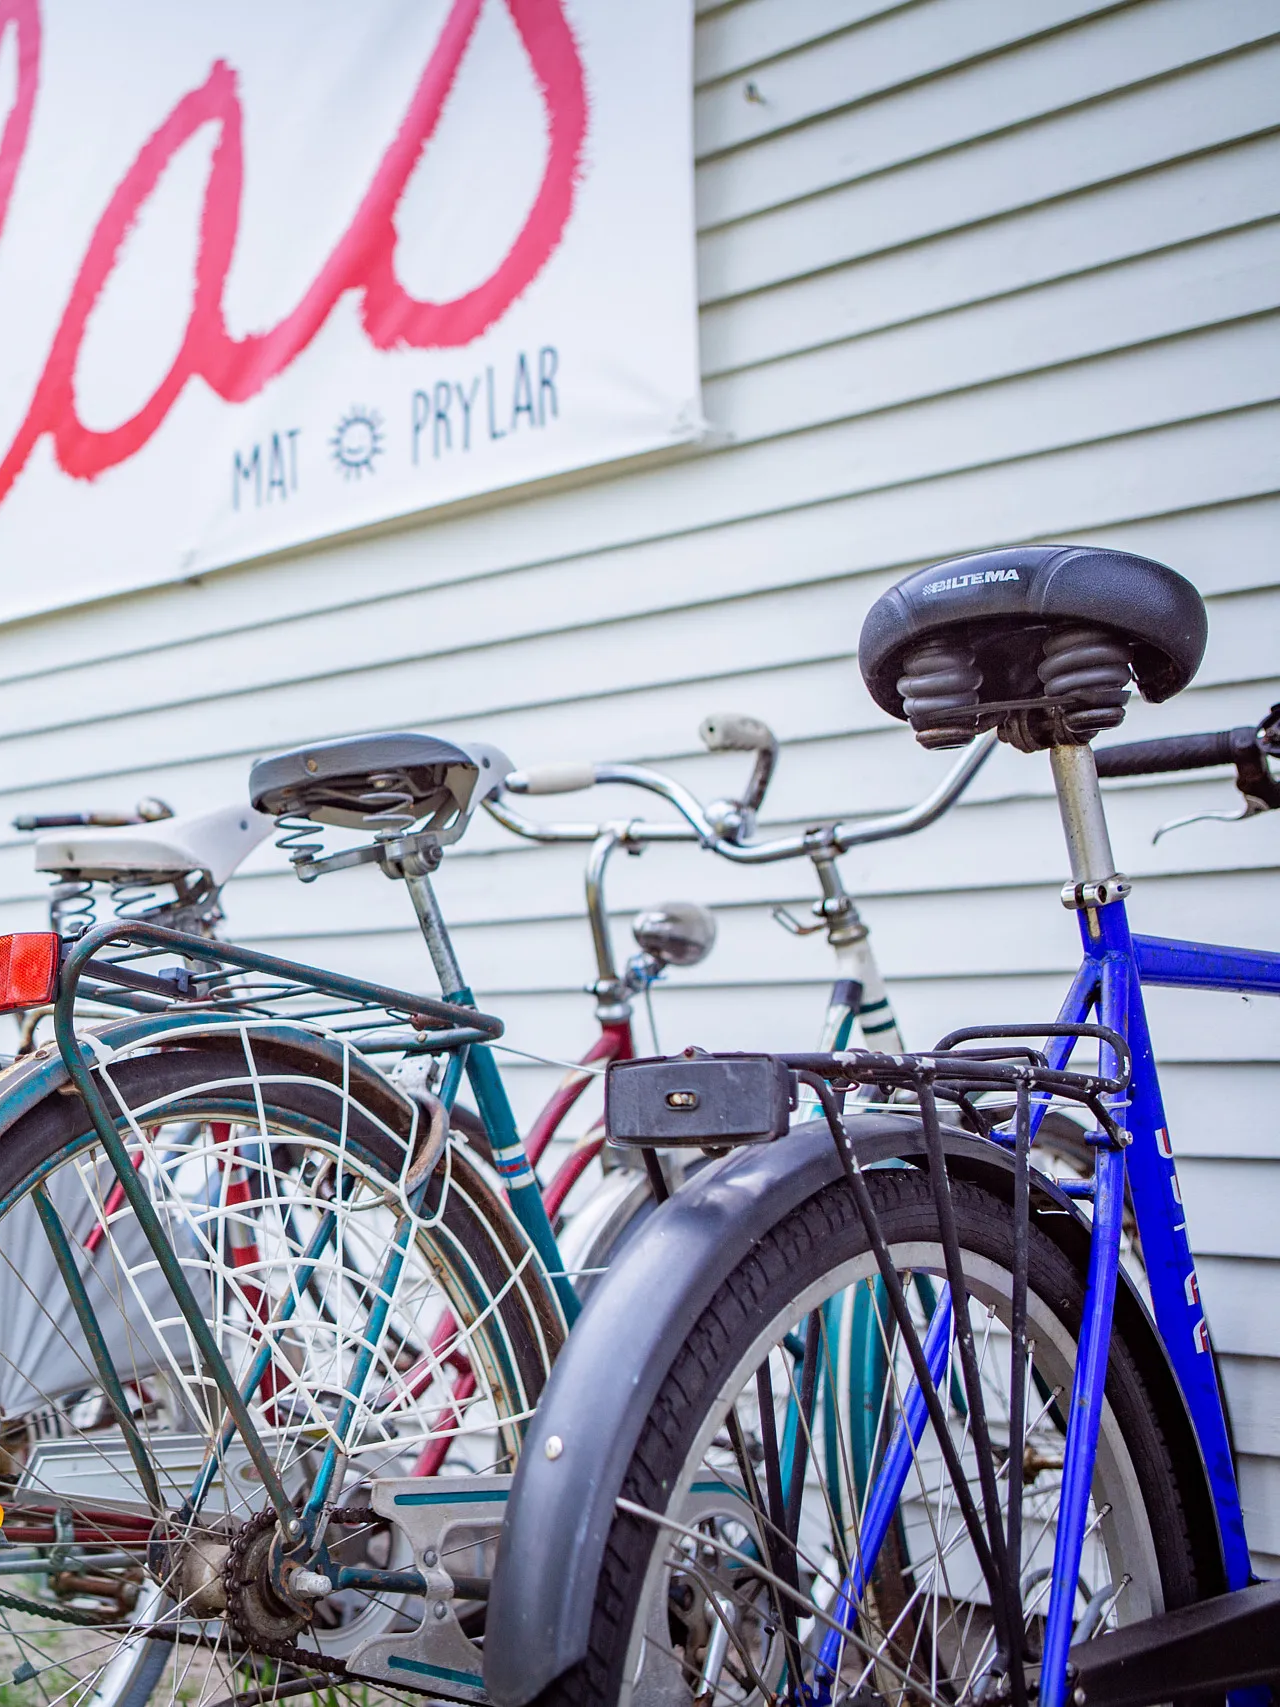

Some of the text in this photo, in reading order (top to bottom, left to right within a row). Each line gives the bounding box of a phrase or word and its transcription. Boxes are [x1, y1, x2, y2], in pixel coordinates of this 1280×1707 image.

[232, 346, 559, 511] MAT PRYLAR
[930, 568, 1020, 594] BILTEMA
